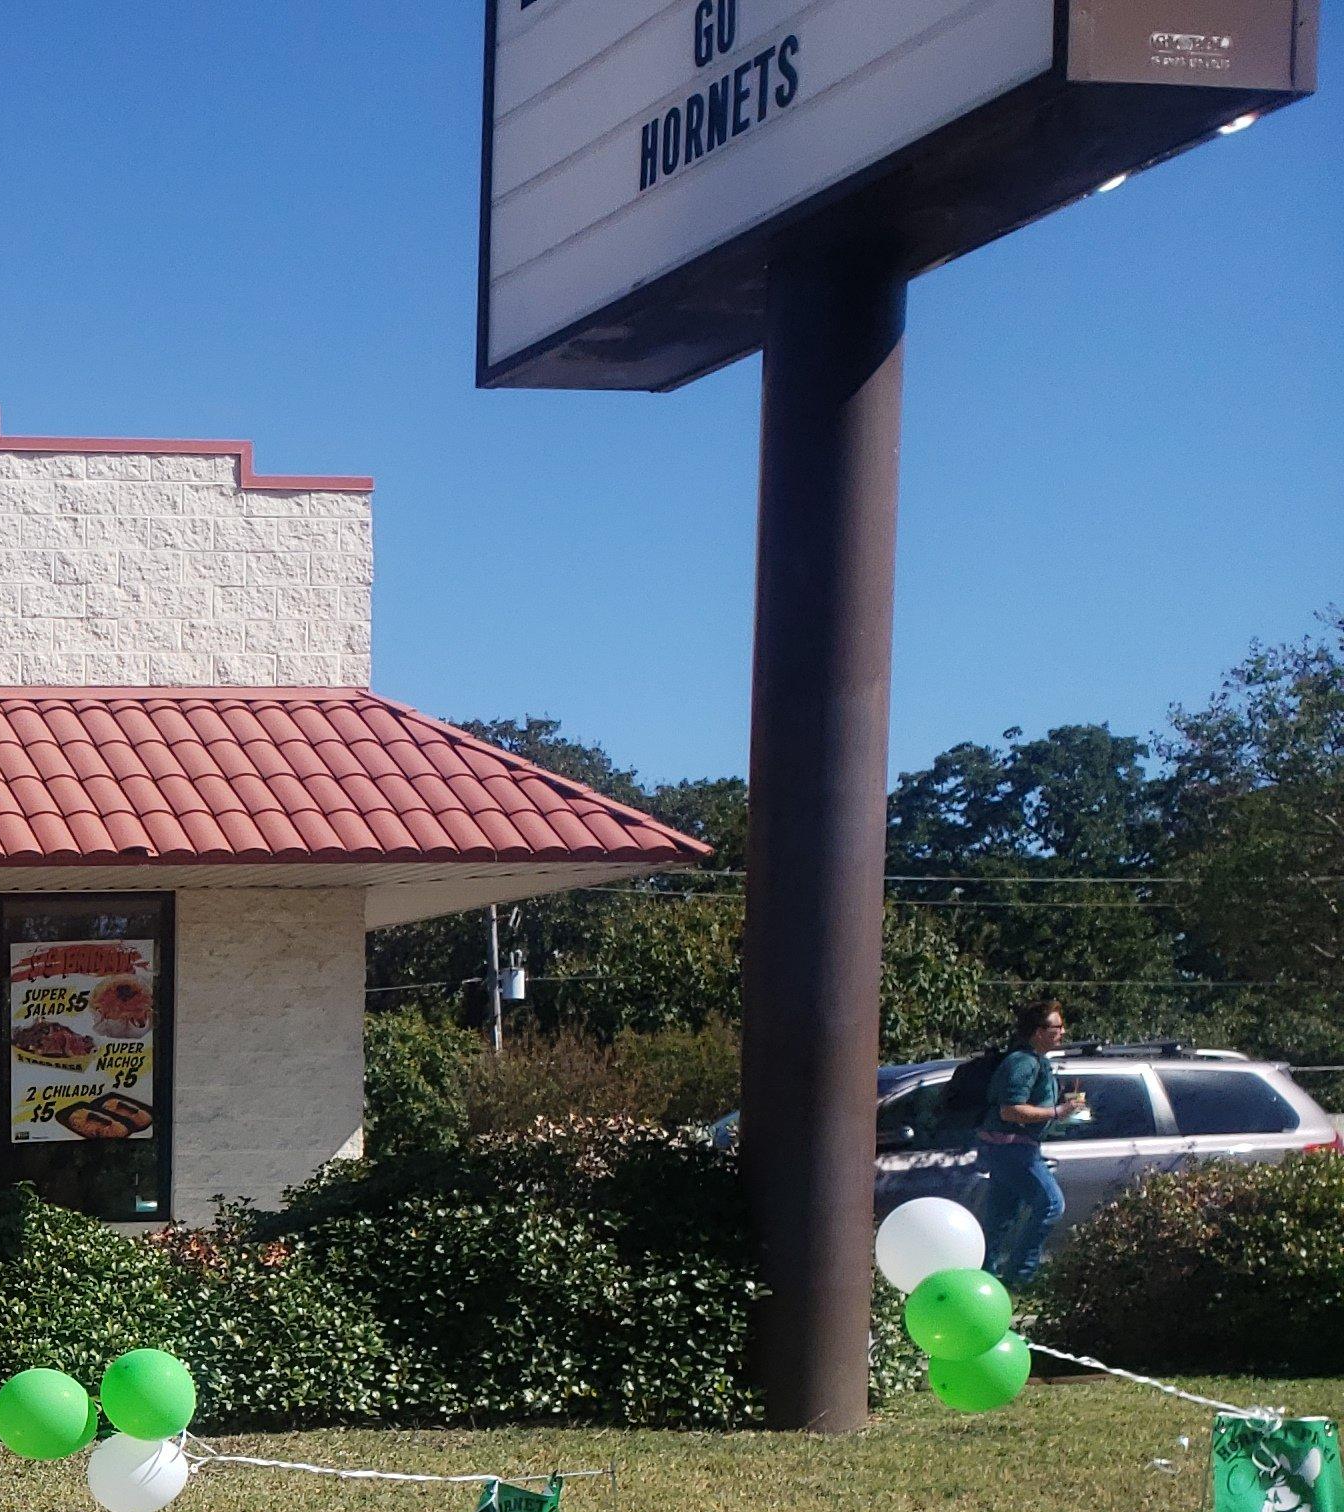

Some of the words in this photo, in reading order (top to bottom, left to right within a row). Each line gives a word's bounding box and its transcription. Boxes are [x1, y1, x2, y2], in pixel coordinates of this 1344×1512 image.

[694, 0, 736, 67] GO
[639, 34, 800, 191] HORNETS
[23, 988, 67, 1005] SUPER
[66, 990, 90, 1012] $5
[24, 1003, 66, 1019] SALAD
[103, 1042, 144, 1057] SUPER
[96, 1056, 145, 1072] NACHOS
[112, 1068, 139, 1089] $5
[26, 1087, 37, 1102] 2
[42, 1083, 105, 1101] CHILADAS
[30, 1101, 57, 1123] $5
